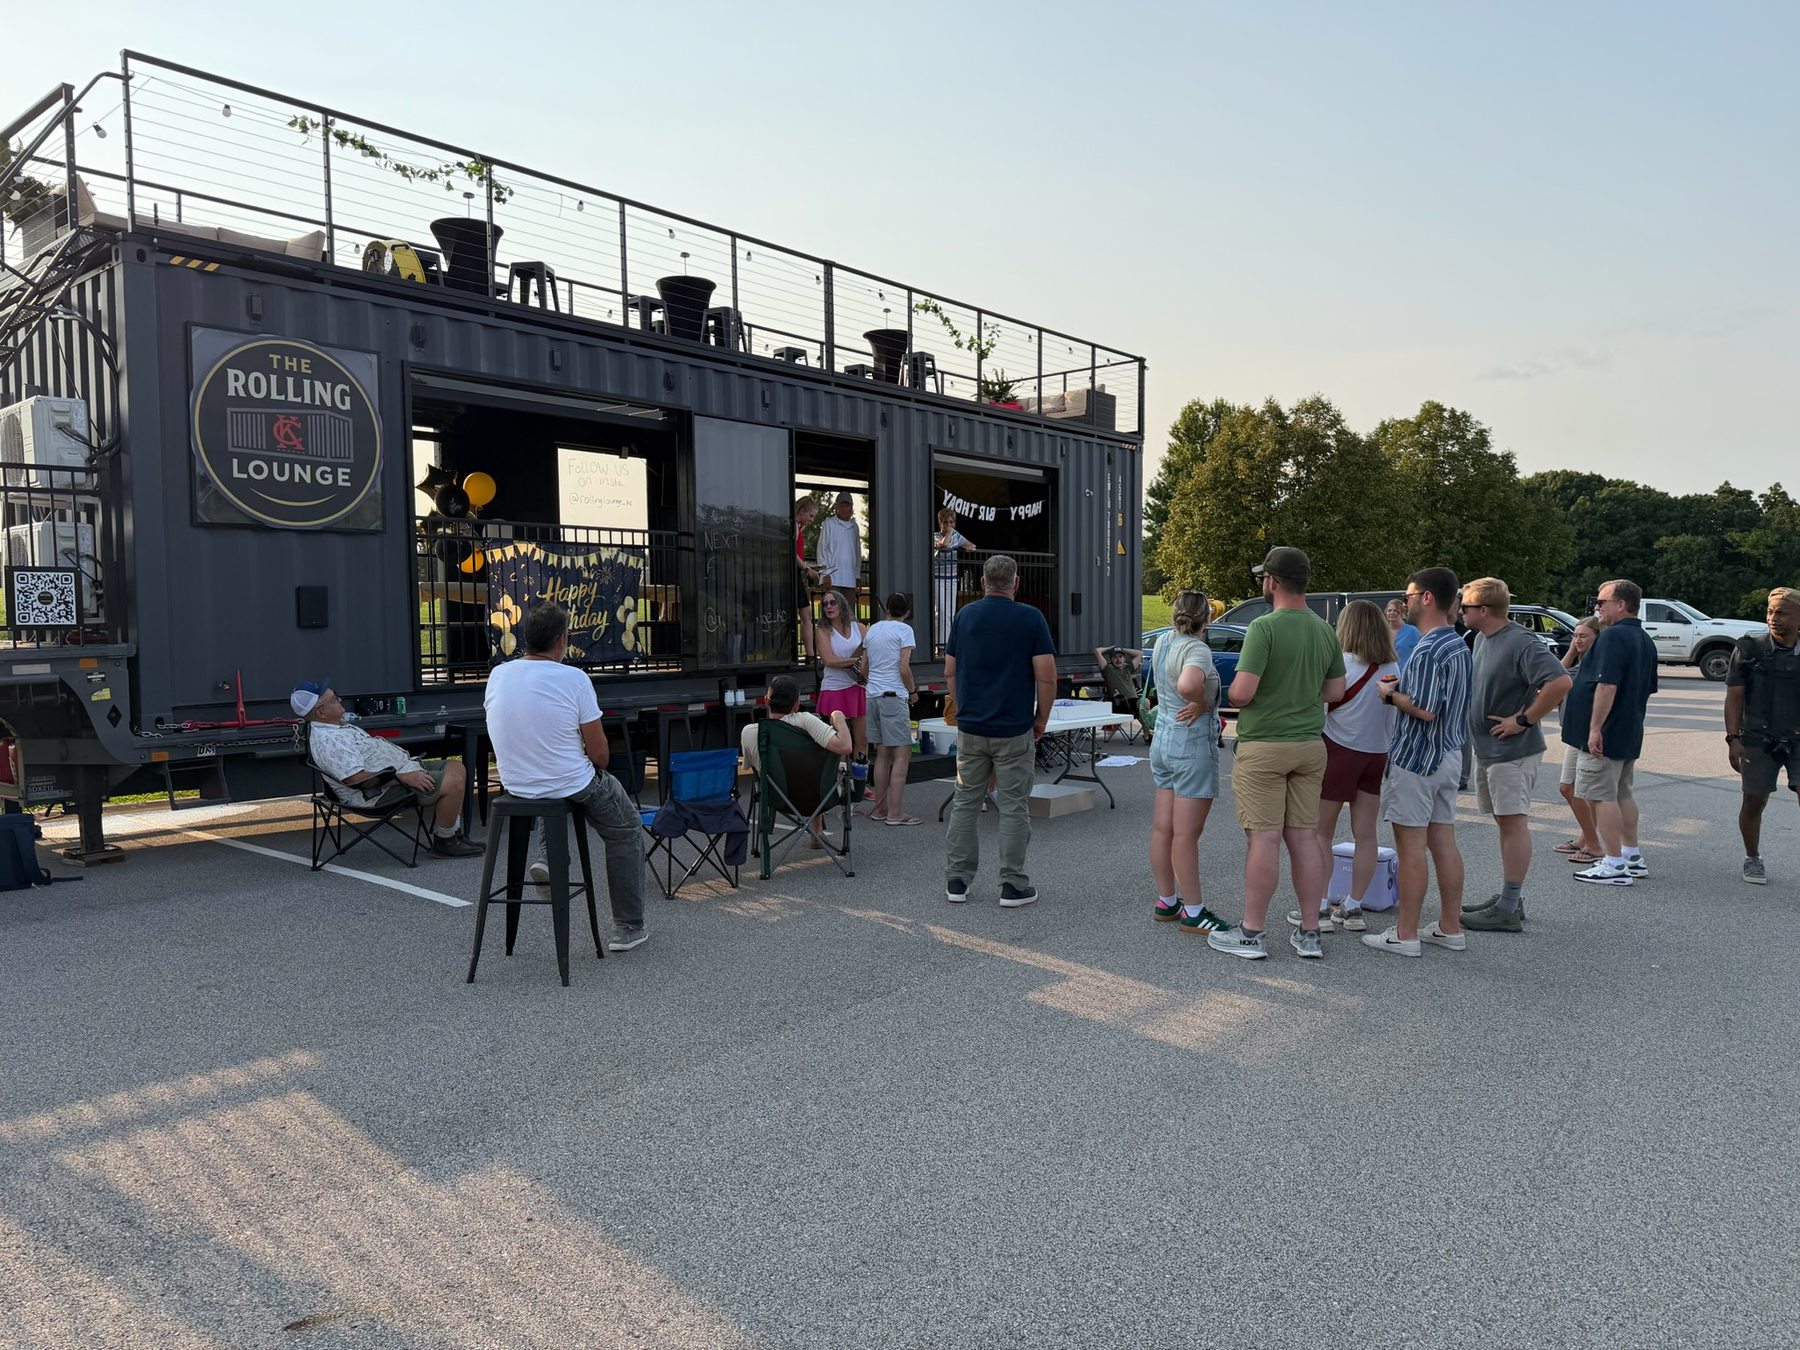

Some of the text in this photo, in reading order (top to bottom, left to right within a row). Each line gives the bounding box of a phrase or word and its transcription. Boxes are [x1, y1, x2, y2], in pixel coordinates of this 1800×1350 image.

[269, 353, 312, 374] THE
[226, 368, 351, 411] ROLLING
[232, 458, 352, 487] LOUNGE
[704, 531, 739, 551] NEXT
[536, 576, 606, 608] Happy
[567, 603, 610, 641] thday
